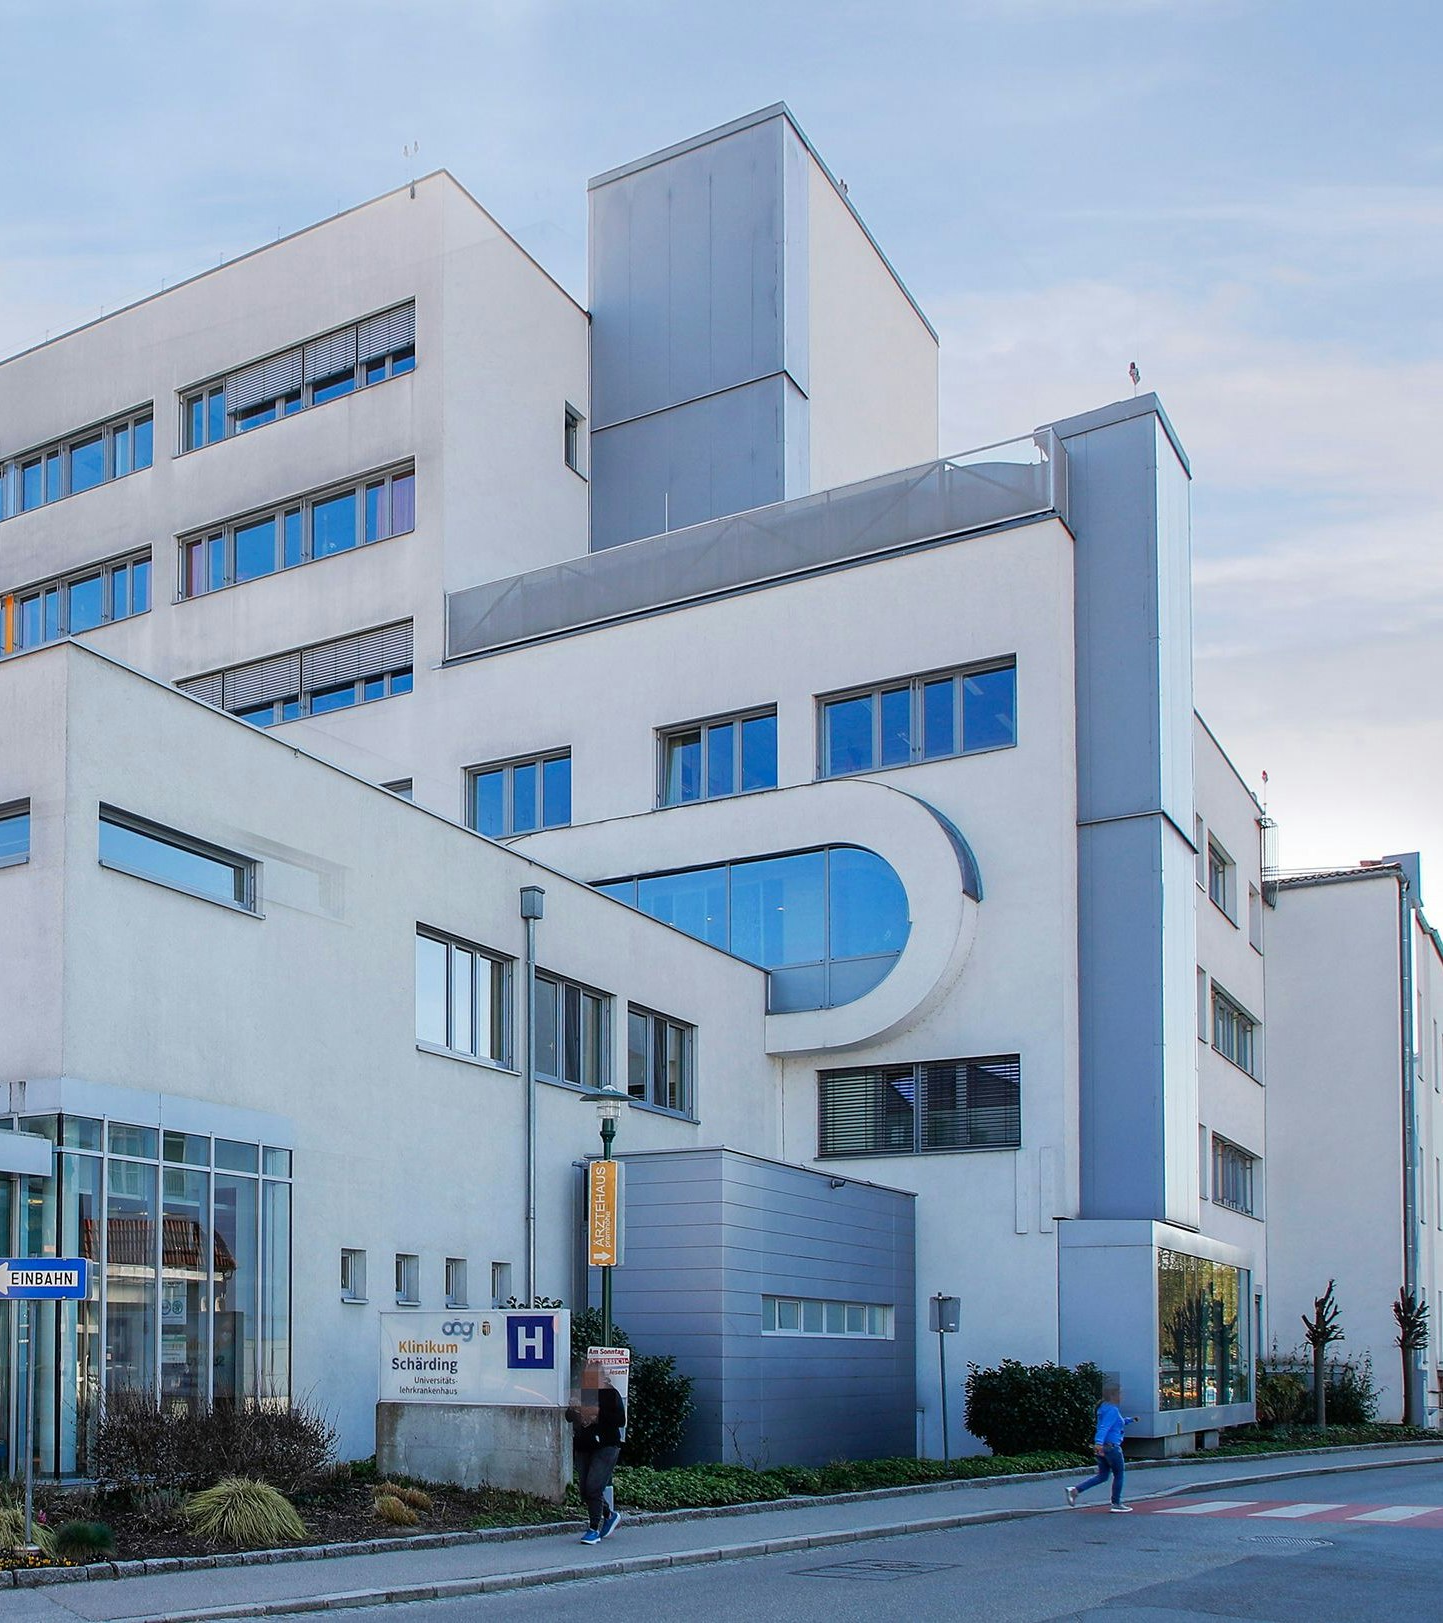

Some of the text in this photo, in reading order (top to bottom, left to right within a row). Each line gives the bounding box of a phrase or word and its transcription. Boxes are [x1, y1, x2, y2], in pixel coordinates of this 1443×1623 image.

[593, 1167, 606, 1247] ÄRZTEHAUS
[11, 1272, 73, 1285] EINBAHN
[399, 1341, 458, 1353] Klinikum
[517, 1326, 543, 1359] H
[392, 1357, 458, 1374] Schärding
[414, 1377, 458, 1385] Universitäts-
[399, 1386, 458, 1395] lehrkrankenhaus
